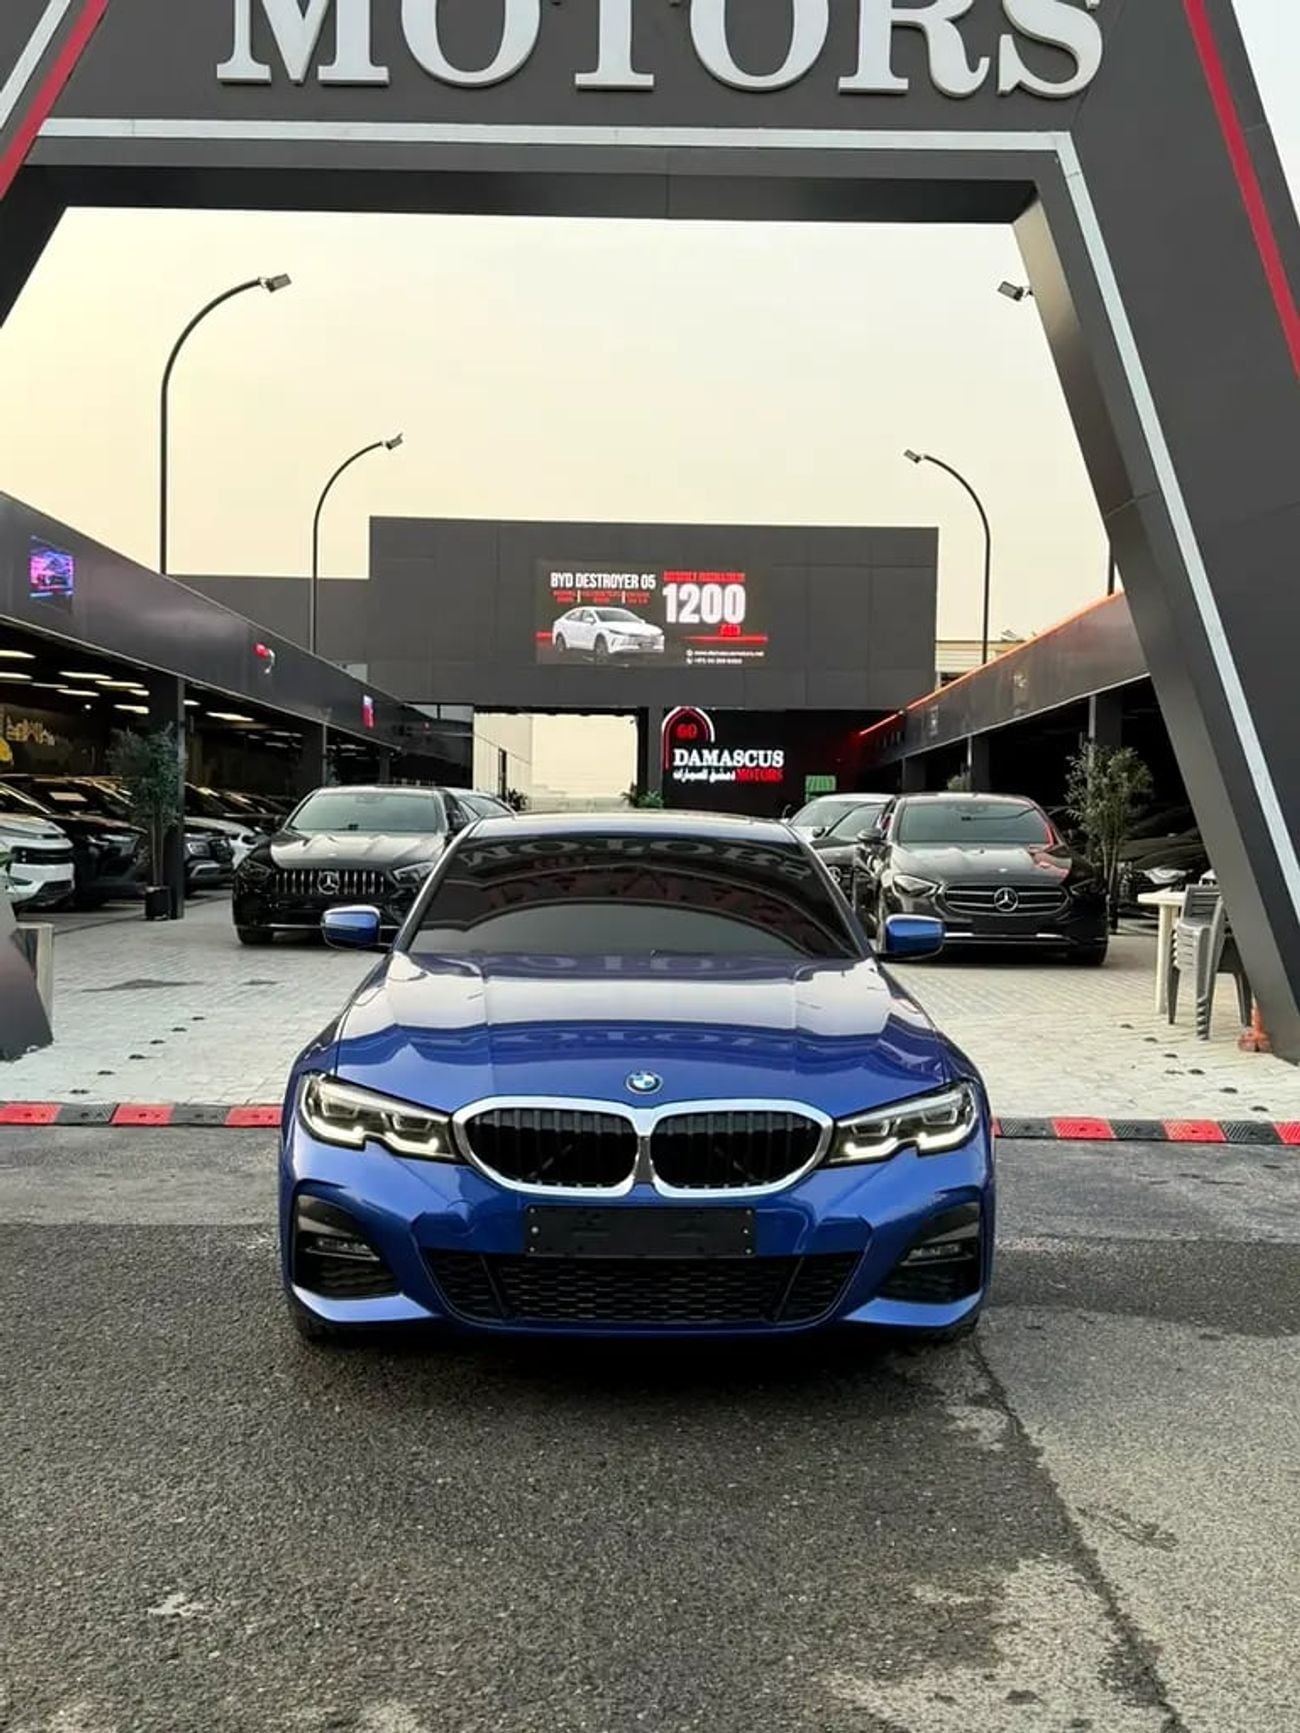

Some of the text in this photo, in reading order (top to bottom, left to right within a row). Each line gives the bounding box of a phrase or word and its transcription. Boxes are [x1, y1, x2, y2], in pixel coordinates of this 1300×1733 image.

[216, 0, 1104, 99] MOTORS
[550, 572, 574, 588] BYD
[575, 573, 639, 589] DESTROYER
[641, 573, 657, 590] 05
[662, 583, 746, 624] 1200
[673, 748, 784, 768] DAMASCUS
